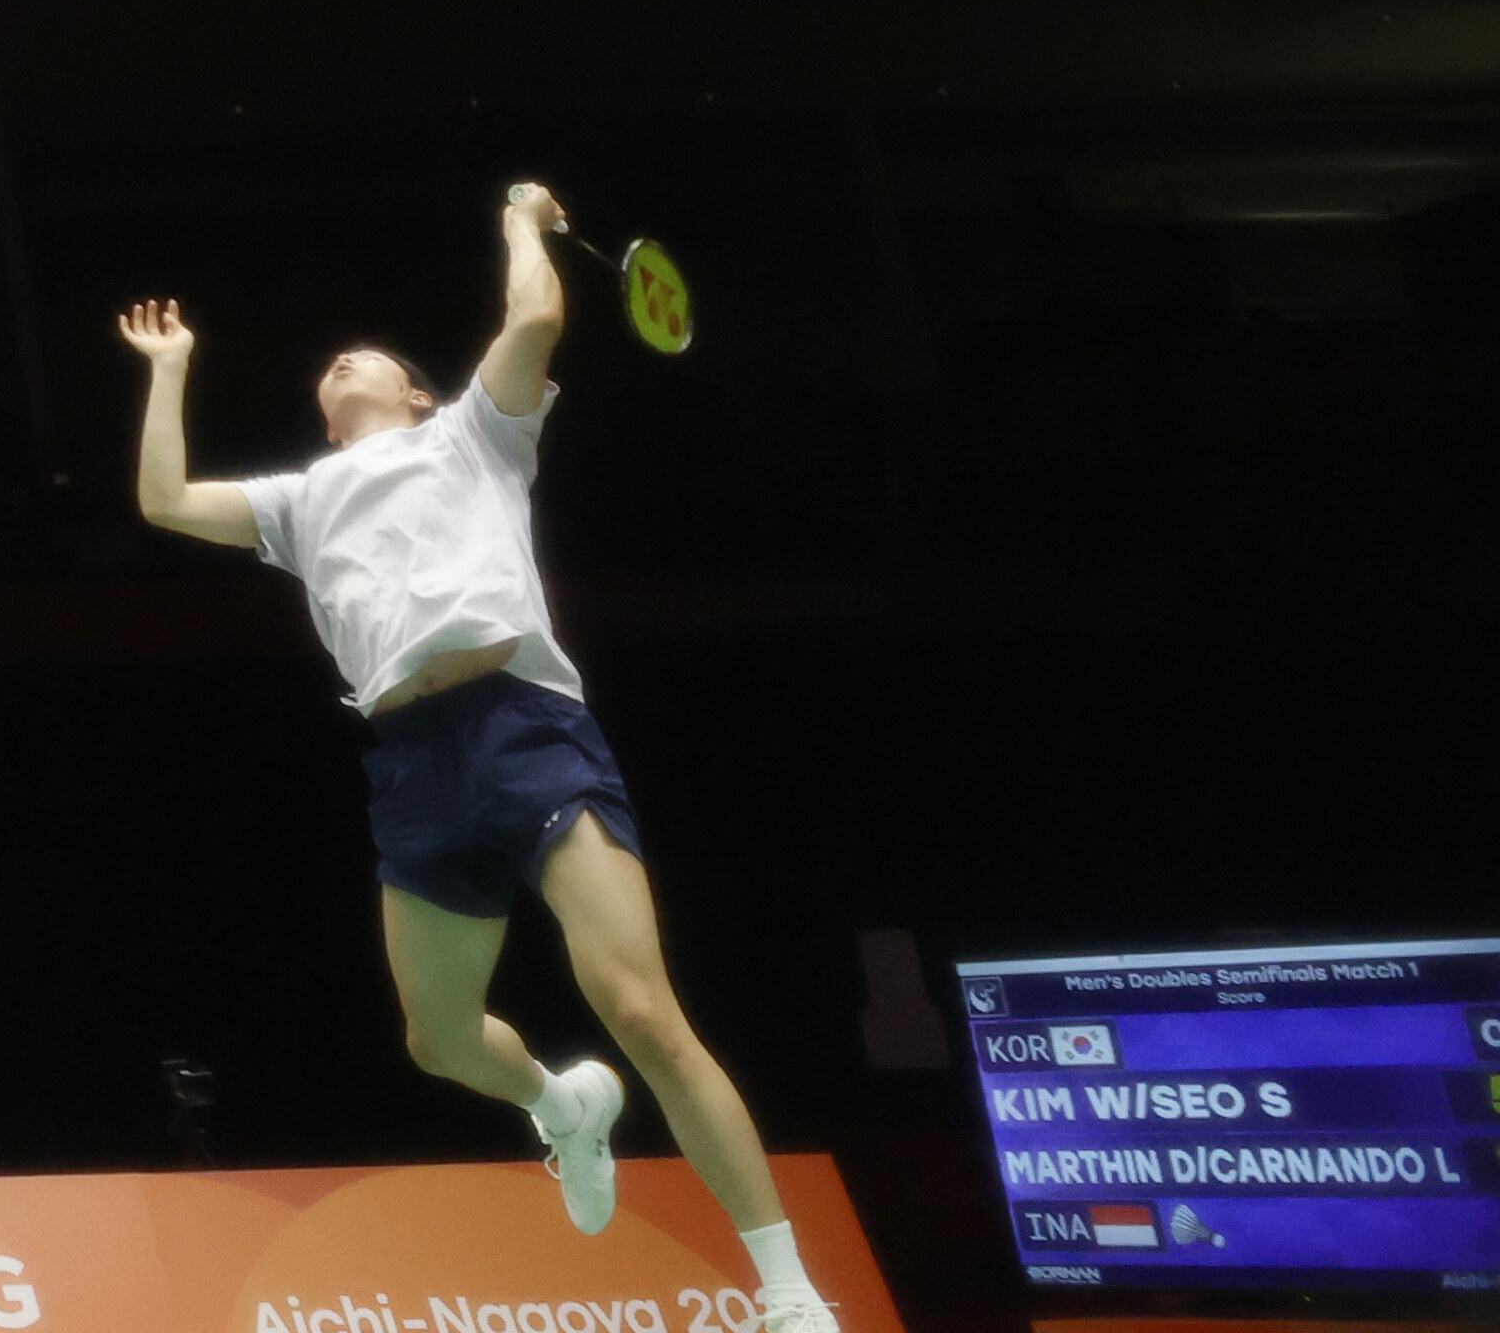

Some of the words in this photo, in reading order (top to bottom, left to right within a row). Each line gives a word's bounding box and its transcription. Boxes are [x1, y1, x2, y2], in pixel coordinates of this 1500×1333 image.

[1065, 973, 1123, 992] Men's
[1129, 970, 1212, 989] Doubles
[1217, 965, 1327, 985] Semifinals
[1334, 962, 1404, 981] Match
[1410, 961, 1419, 977] 1
[1217, 991, 1266, 1006] Score
[987, 1035, 1050, 1064] KOR
[992, 1087, 1074, 1122] KIM
[1085, 1084, 1246, 1121] W/SEO
[1260, 1081, 1292, 1118] S
[1004, 1148, 1164, 1185] MARTHIN
[1169, 1146, 1426, 1184] D/CARNANDO
[1435, 1147, 1461, 1183] L
[1024, 1211, 1092, 1242] INA
